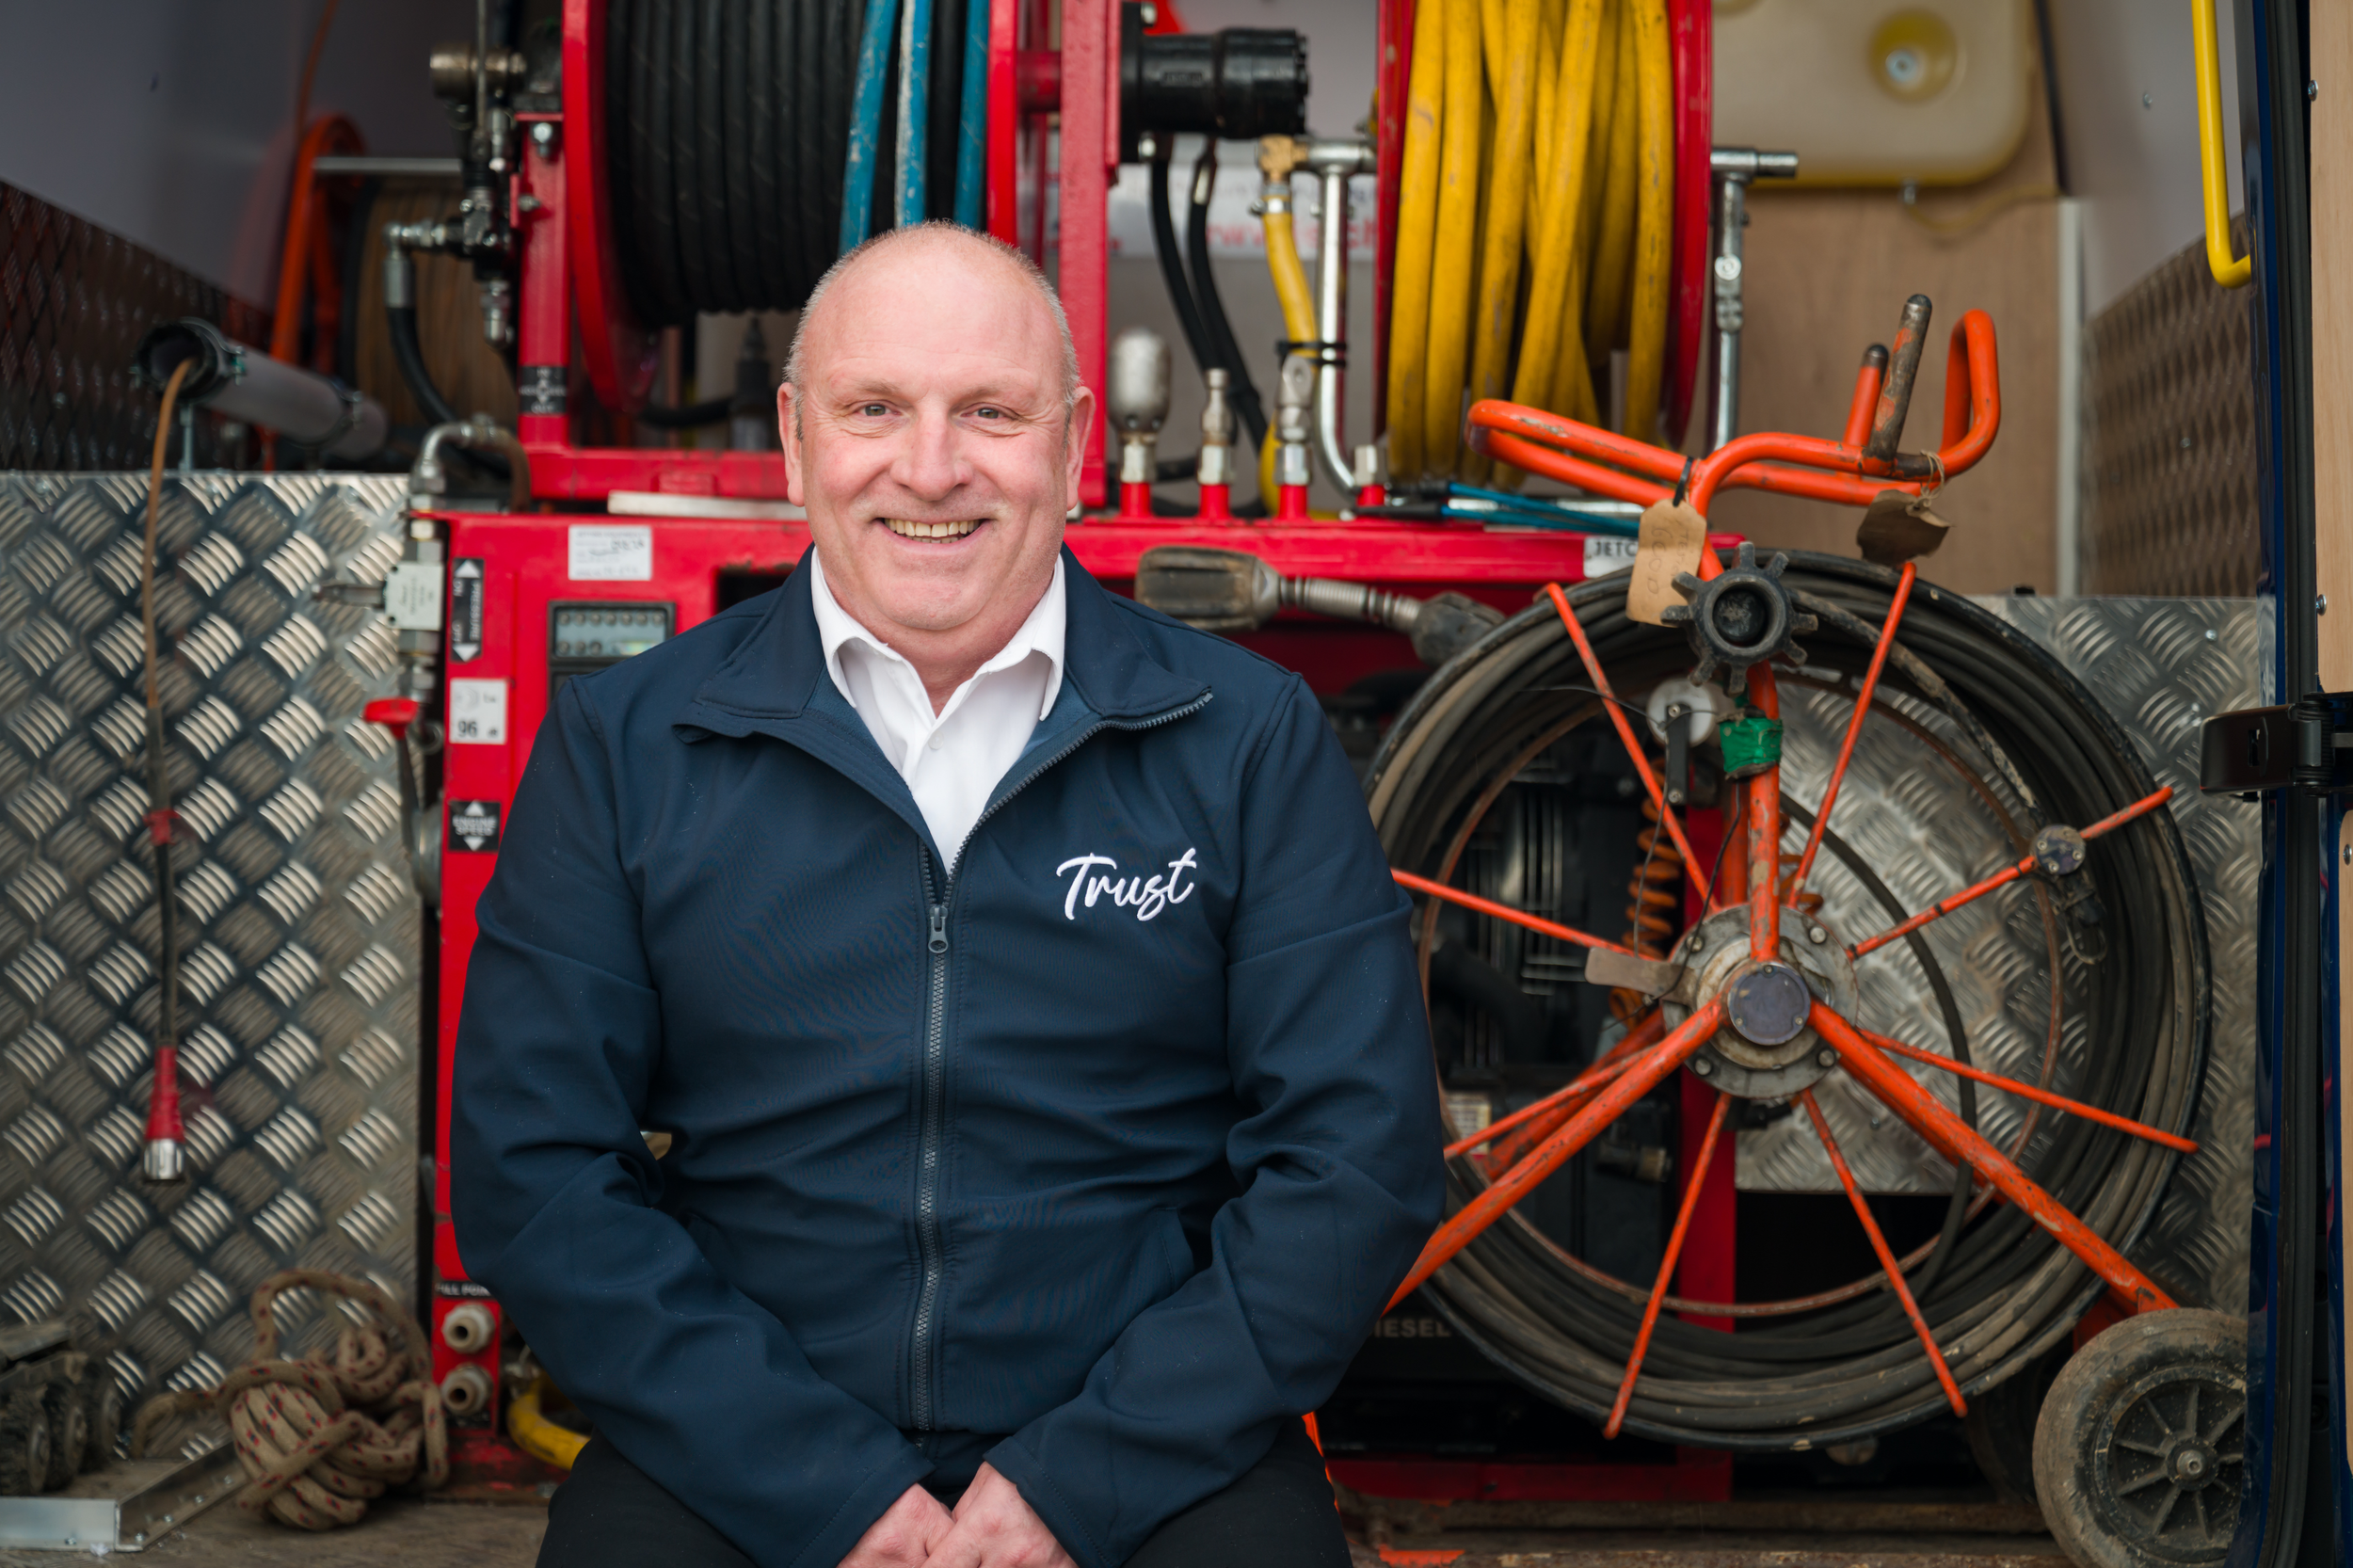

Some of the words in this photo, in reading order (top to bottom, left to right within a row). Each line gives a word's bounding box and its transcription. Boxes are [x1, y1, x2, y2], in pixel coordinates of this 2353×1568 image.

[453, 577, 464, 597] ON
[470, 580, 482, 641] PRESSURE
[452, 620, 463, 643] OFF
[457, 720, 478, 738] 96
[453, 816, 498, 828] ENGINE
[456, 827, 494, 836] SPEED
[1056, 847, 1197, 921] Trust
[461, 1283, 491, 1297] POIN
[1374, 1318, 1449, 1337] IESEL
